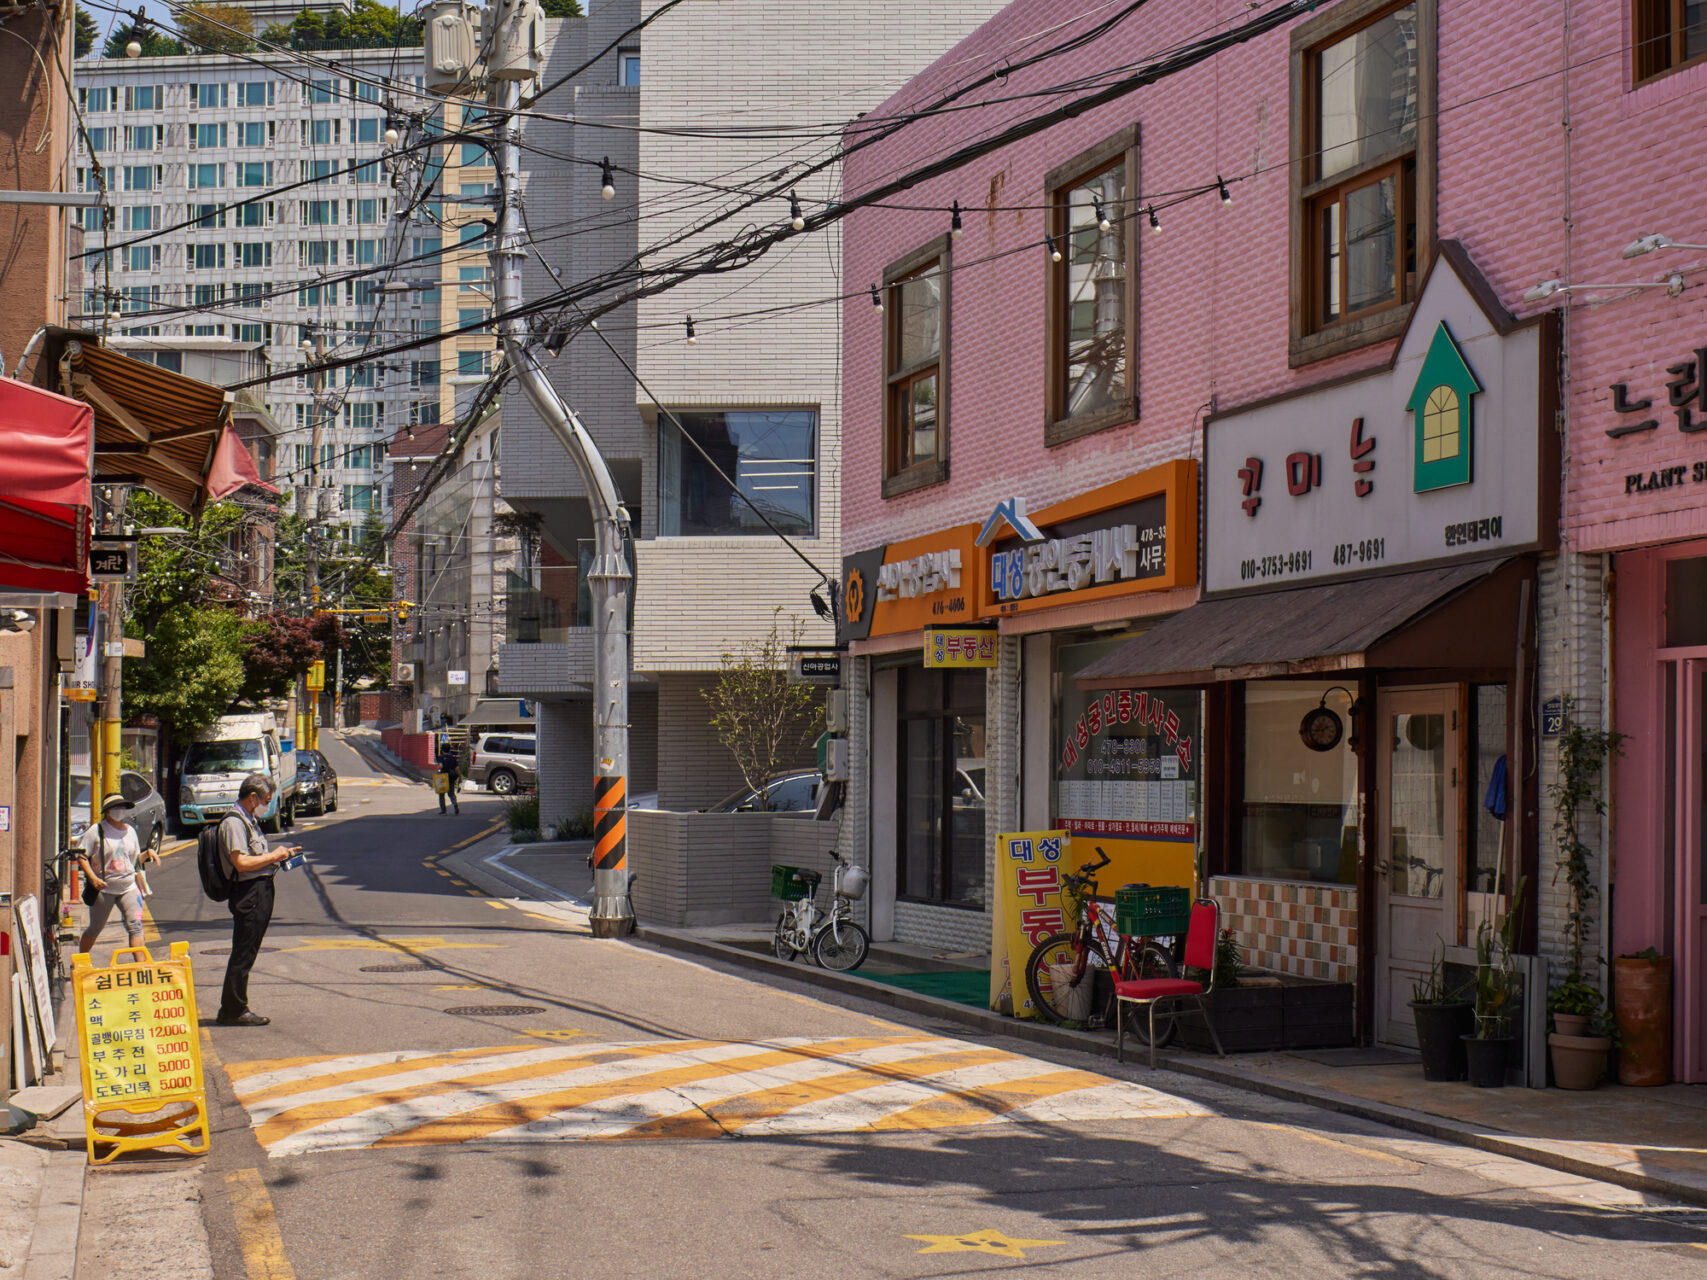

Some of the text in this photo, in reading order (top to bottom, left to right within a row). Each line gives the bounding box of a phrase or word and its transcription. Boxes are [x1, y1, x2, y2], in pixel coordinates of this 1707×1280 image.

[1237, 418, 1376, 517] 꾸미는
[1624, 465, 1687, 494] PLANT
[95, 554, 123, 571] 계란
[1140, 545, 1166, 571] 사무
[1240, 538, 1385, 581] 010-3753-9691 487-9691
[877, 549, 962, 602] 신아공업사
[946, 635, 994, 660] 부동산
[803, 662, 838, 671] 신아공업사
[1548, 716, 1562, 732] 29
[1009, 838, 1061, 862] 대성
[91, 1028, 145, 1046] 골뱅이무침
[96, 1081, 151, 1098] 도토리묵
